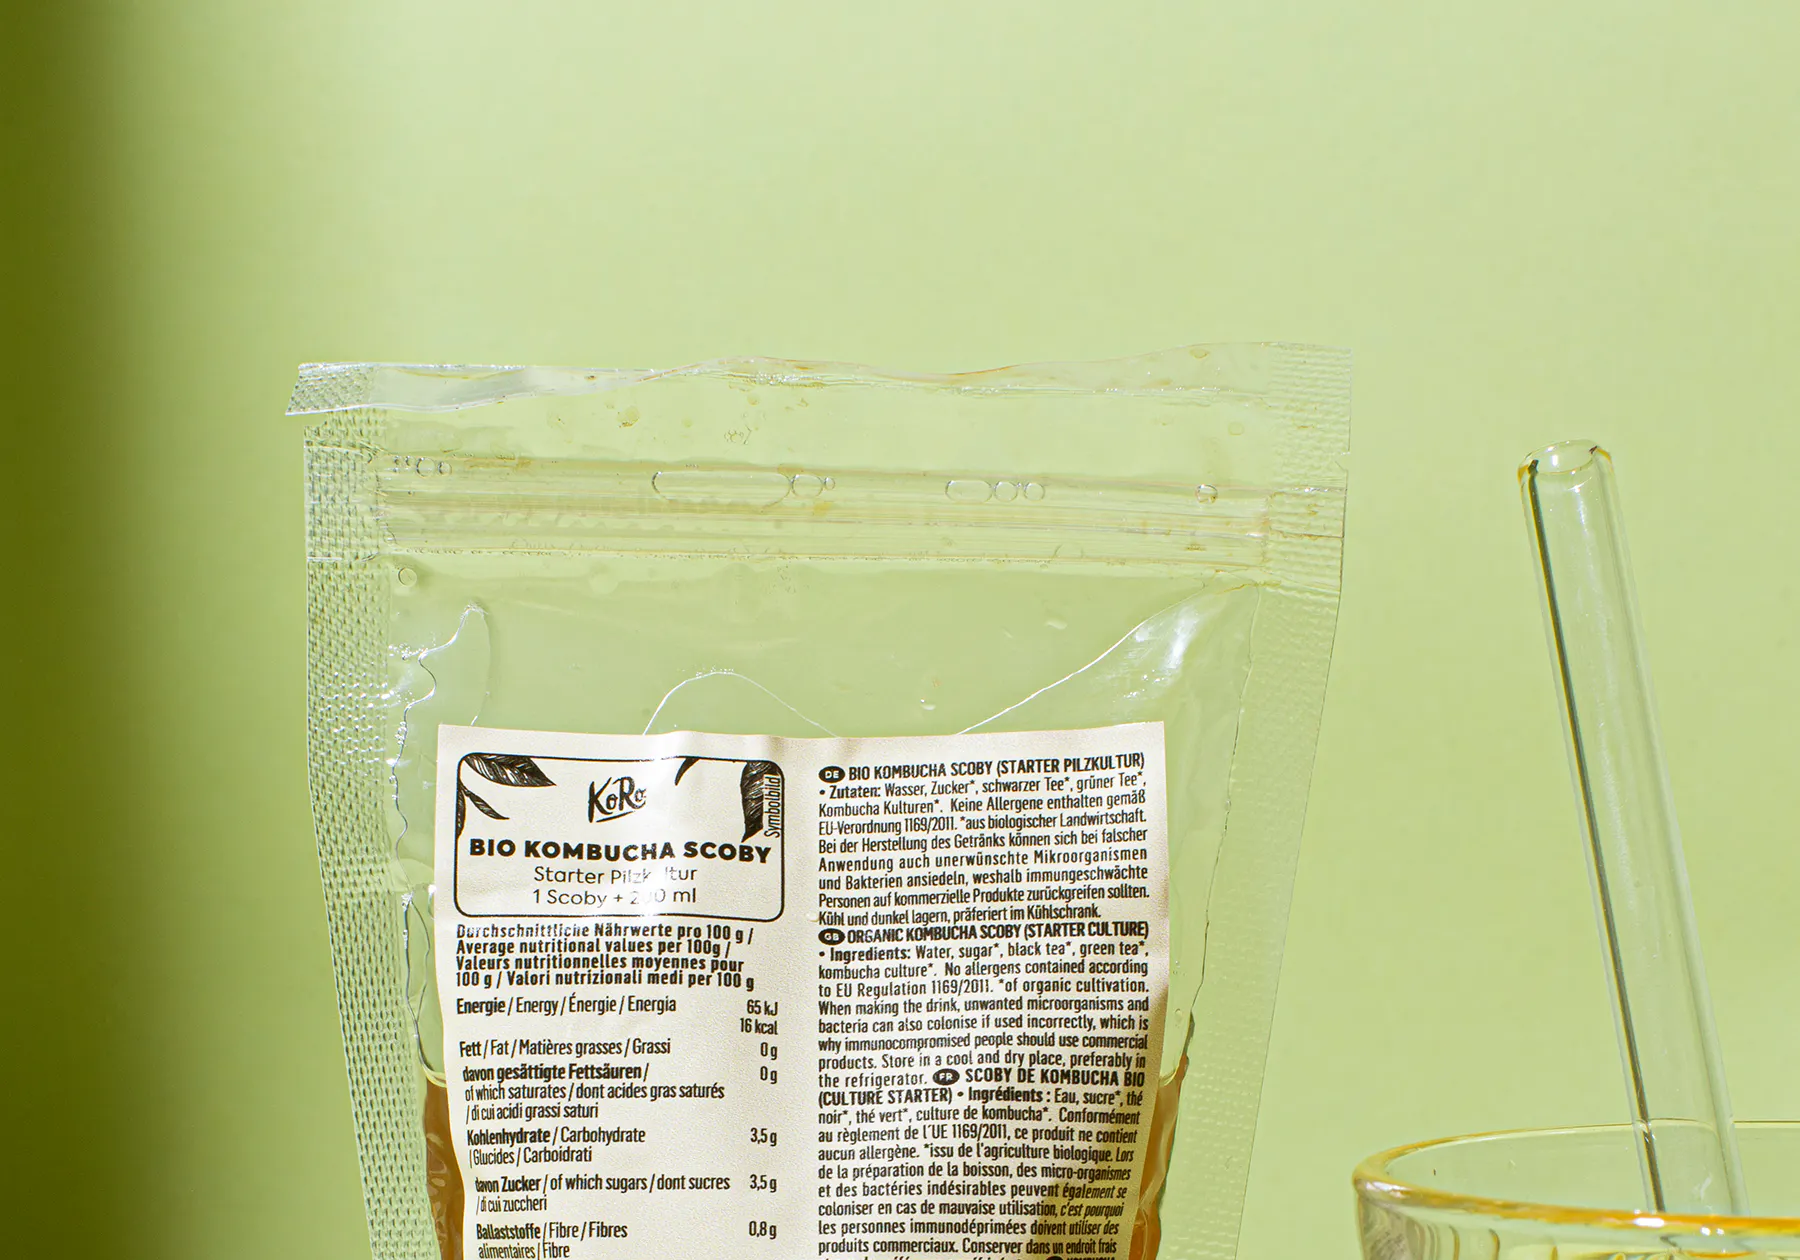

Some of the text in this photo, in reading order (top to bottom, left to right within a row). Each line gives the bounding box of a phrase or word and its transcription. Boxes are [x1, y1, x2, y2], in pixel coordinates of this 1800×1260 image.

[848, 766, 870, 781] BIO
[874, 763, 946, 780] KOMBUCHA
[950, 762, 992, 777] SCOBY
[996, 759, 1060, 779] (STARTER
[1063, 754, 1144, 776] PILZKULTUR)
[588, 777, 646, 823] KoRo
[764, 776, 780, 838] Symbolbild
[818, 809, 1146, 838] EU-Verordnung 1169/2011. biologischer Landwirtschaft.
[470, 839, 771, 863] BIO KOMBUCHA SCOBY
[818, 828, 1148, 855] Bei der Herstellung des Getränks können sich bei falscher
[818, 846, 1147, 875] Anwendung auch unerwünschte Mikroorganismen
[534, 867, 697, 883] Starter Pilzkltur
[818, 866, 1148, 890] und Bakterien ansiedeln, weshalb immungeschwächte
[533, 889, 696, 908] 1 Scoby + 20 ml
[818, 885, 1150, 908] Personen auf kommerzielle Produkte zurückgreifen sollten.
[818, 904, 1101, 926] Kühl und dunkel lagern, präferiert im Kühlschrank.
[594, 923, 672, 938] Nährwerte
[677, 927, 702, 941] pro
[706, 924, 730, 939] 100
[735, 928, 744, 942] g
[847, 928, 904, 943] ORGANIC
[906, 926, 978, 942] KOMBUCHA
[980, 925, 1020, 940] SCOBY
[1024, 924, 1086, 943] (STARTER
[1087, 922, 1149, 941] CULTURE)
[456, 939, 720, 958] Average nutritional values per 100g
[456, 955, 744, 974] Valeurs nutritionnelles moyennes pour
[456, 971, 754, 991] 100 g Valori nutrizionali medi per 100 g
[746, 1001, 778, 1016] 65 kJ
[818, 997, 1149, 1018] When making the drink, unwanted microorganisms and
[740, 1019, 778, 1035] 16 kcal
[760, 1043, 778, 1060] 0 g
[818, 1073, 840, 1087] the
[844, 1071, 927, 1089] refrigerator.
[964, 1068, 1012, 1083] SCOBY
[1040, 1069, 1119, 1086] KOMBUCHA
[1124, 1072, 1144, 1087] BIO
[750, 1128, 777, 1147] 3,5 g
[818, 1164, 1131, 1184] de la préparation de la boisson, des micro-organismes
[748, 1221, 776, 1240] 0,8 g
[818, 1221, 1119, 1238] les personnes immunodéprimées doivent utiliser des
